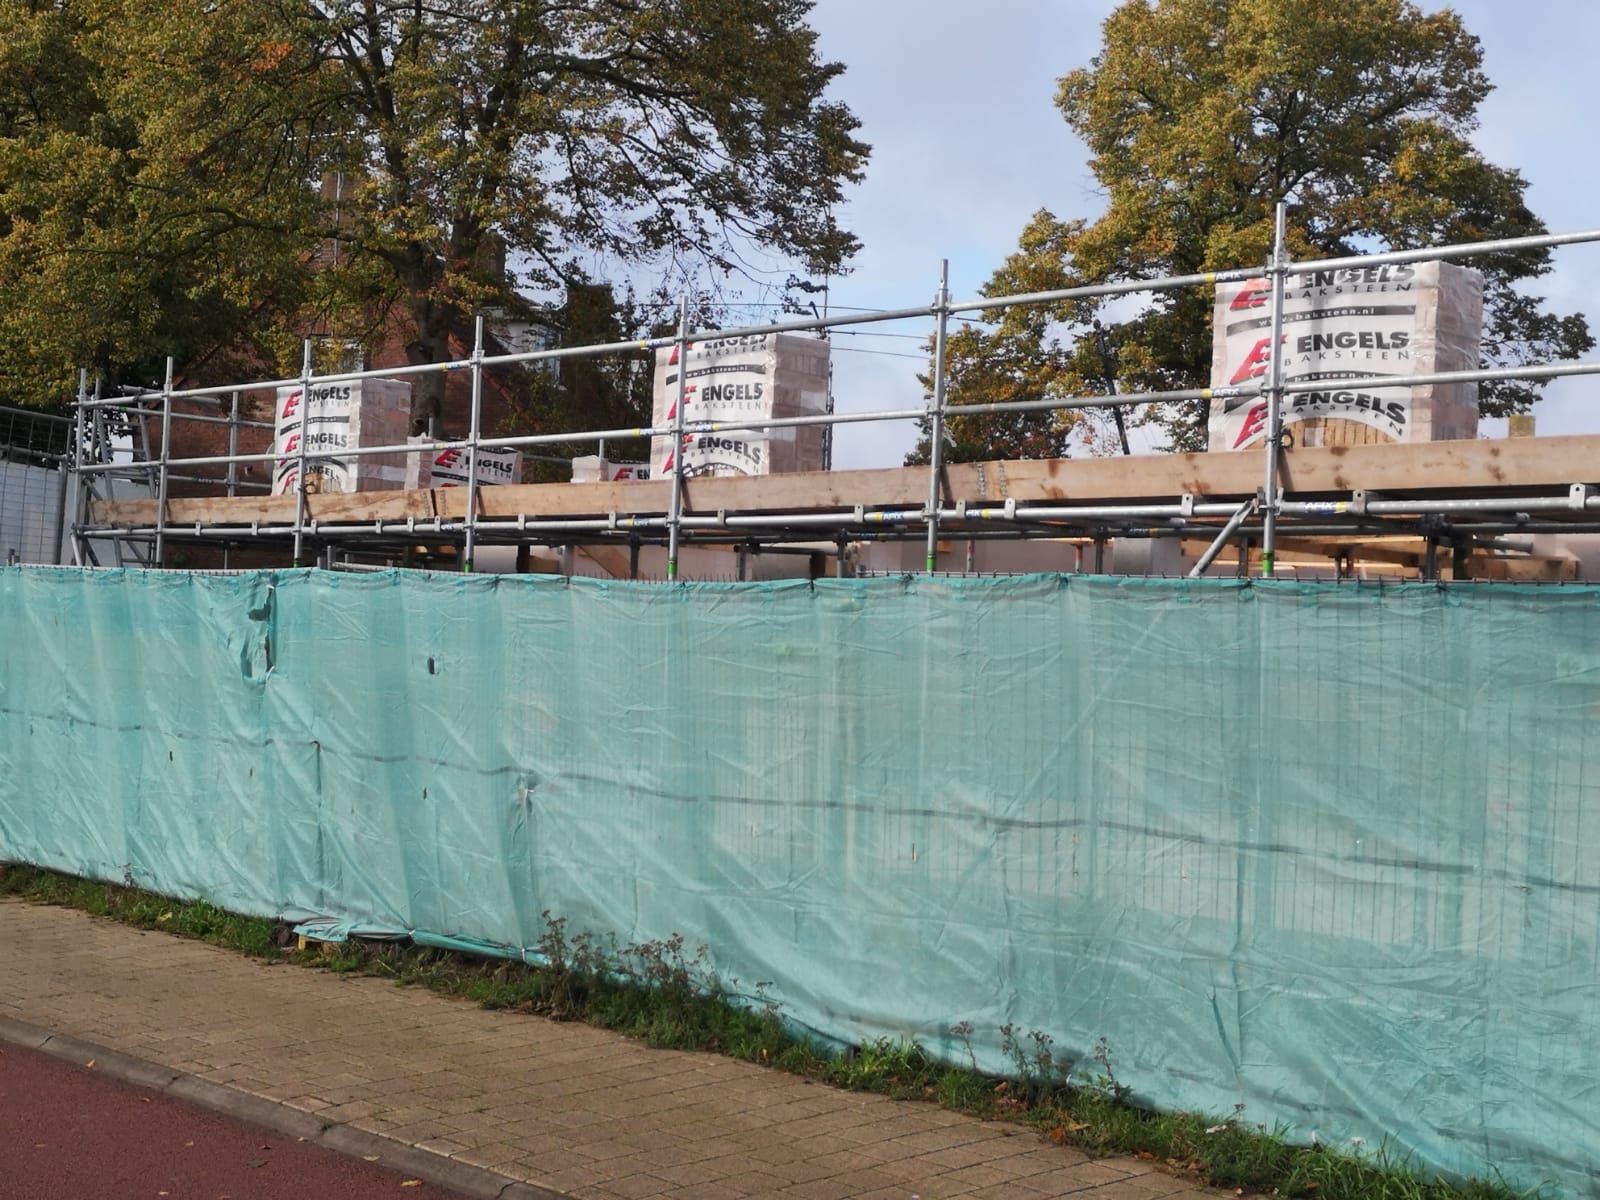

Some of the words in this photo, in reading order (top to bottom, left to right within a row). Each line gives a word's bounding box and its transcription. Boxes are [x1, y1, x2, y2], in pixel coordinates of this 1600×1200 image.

[1285, 283, 1412, 299] BAKSTEEN
[1297, 331, 1410, 354] ENGELS
[1285, 350, 1409, 366] BAKSTEEN
[702, 382, 763, 401] ENGELS
[1292, 391, 1406, 424] ENGELS
[698, 436, 760, 465] ENGELS
